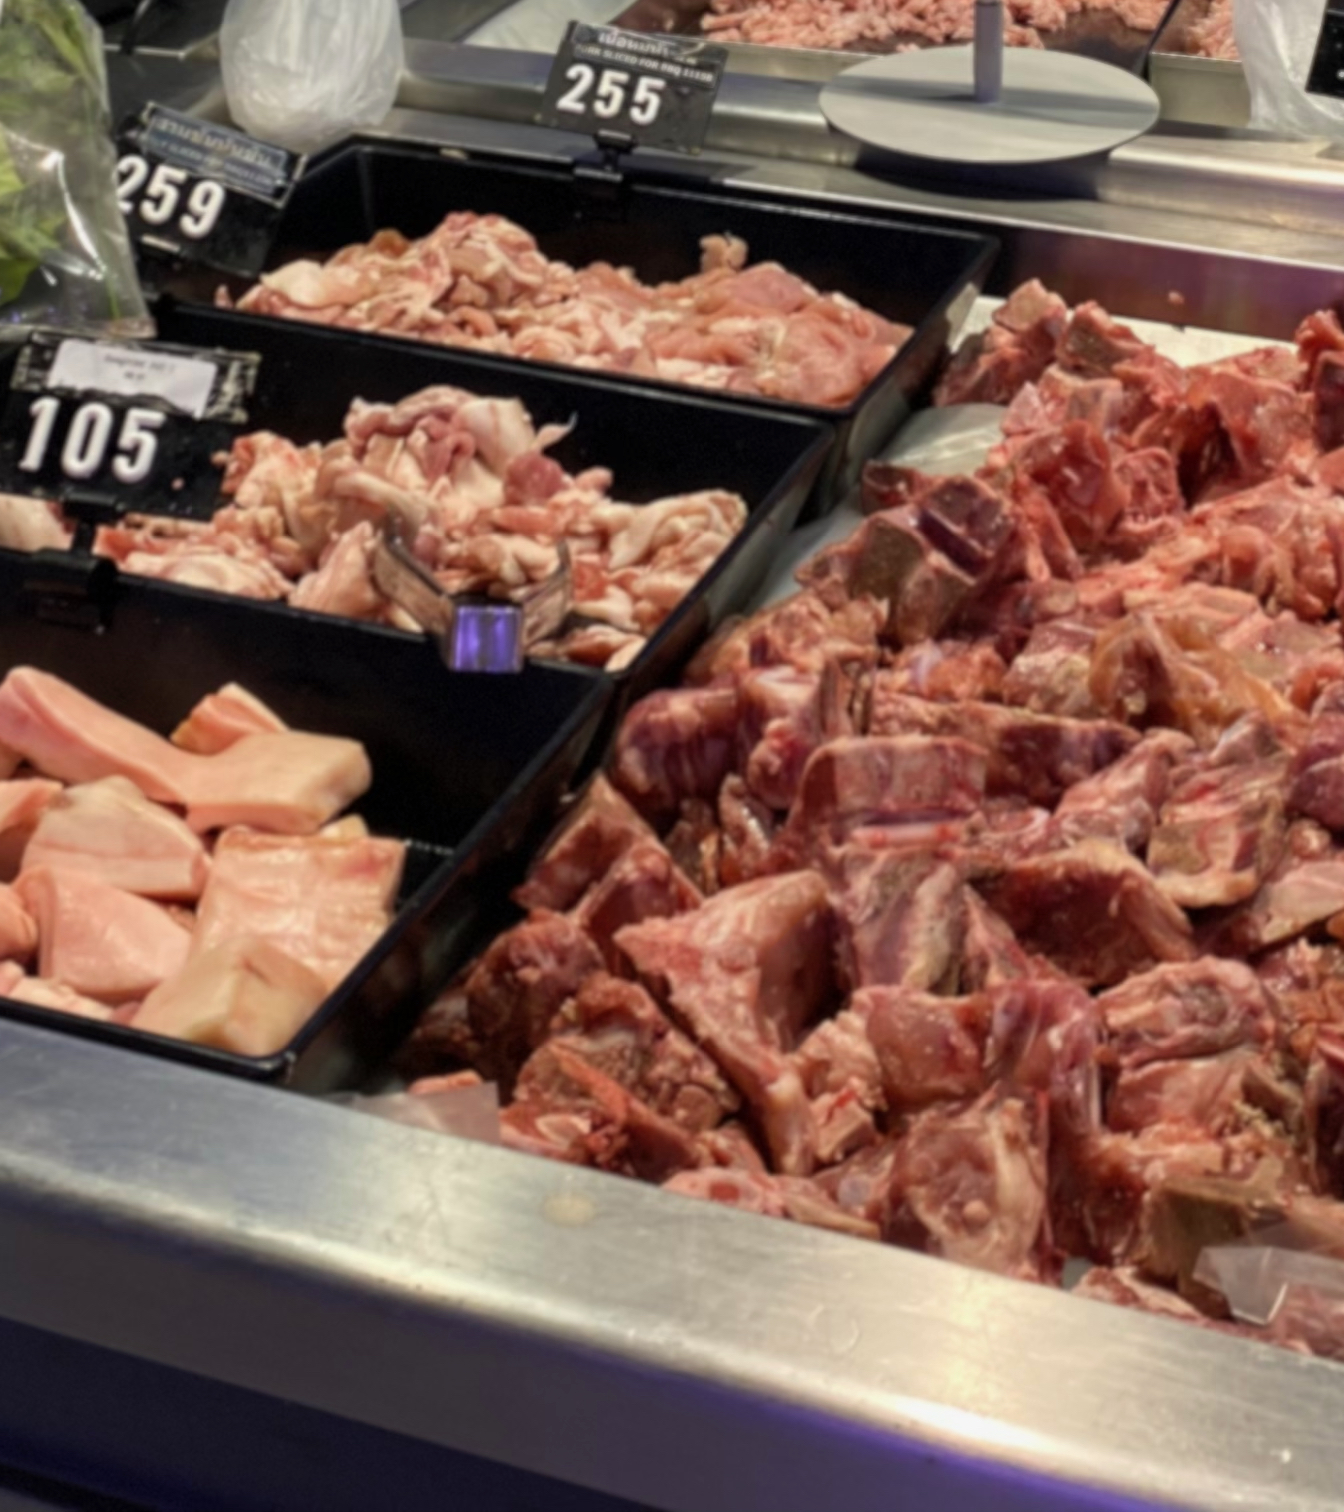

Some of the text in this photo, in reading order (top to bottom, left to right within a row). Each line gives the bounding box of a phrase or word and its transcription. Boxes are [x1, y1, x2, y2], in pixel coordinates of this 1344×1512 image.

[557, 63, 667, 126] 255
[117, 154, 226, 238] 259
[18, 396, 166, 484] 105
